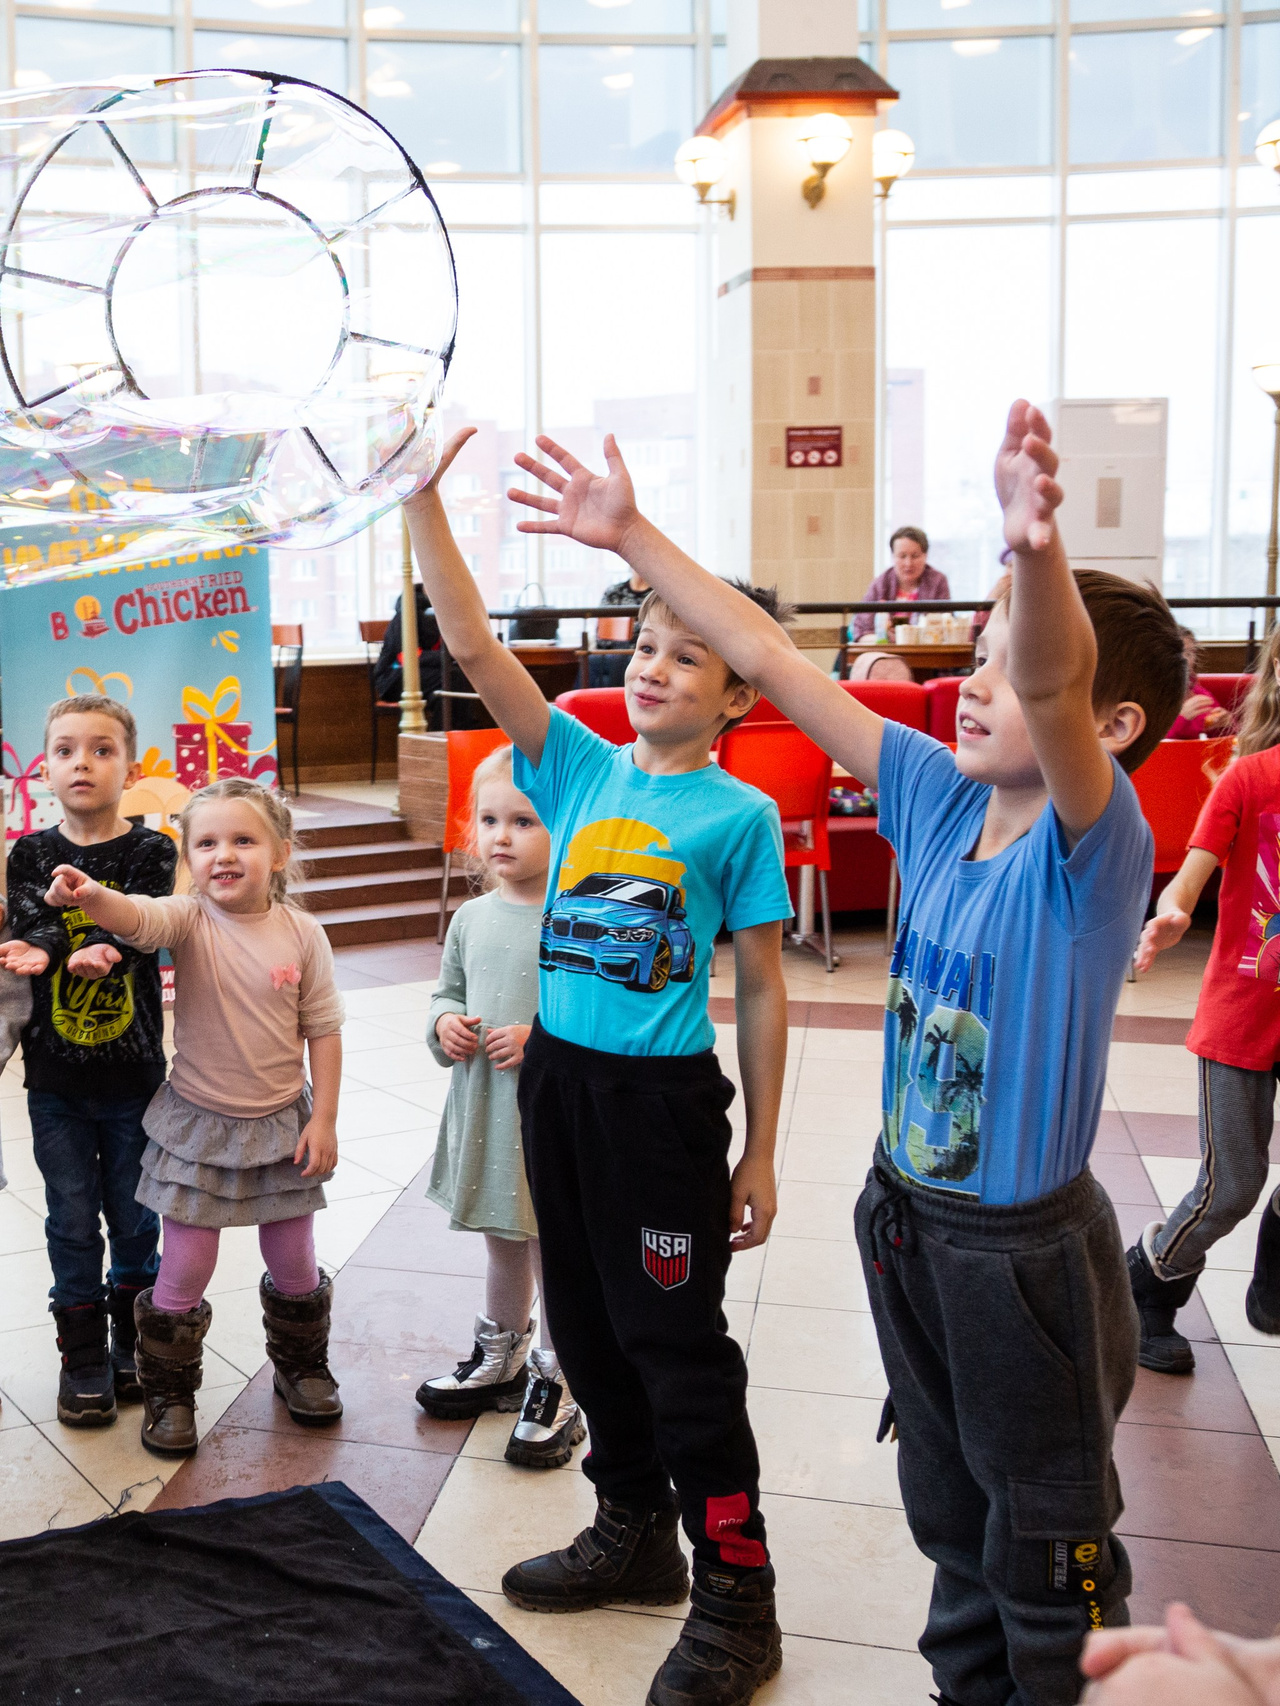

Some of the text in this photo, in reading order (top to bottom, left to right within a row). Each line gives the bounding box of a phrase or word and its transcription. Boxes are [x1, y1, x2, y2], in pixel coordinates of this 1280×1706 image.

[198, 570, 243, 588] FRIED
[113, 584, 252, 636] Chicken
[645, 1232, 687, 1258] USA
